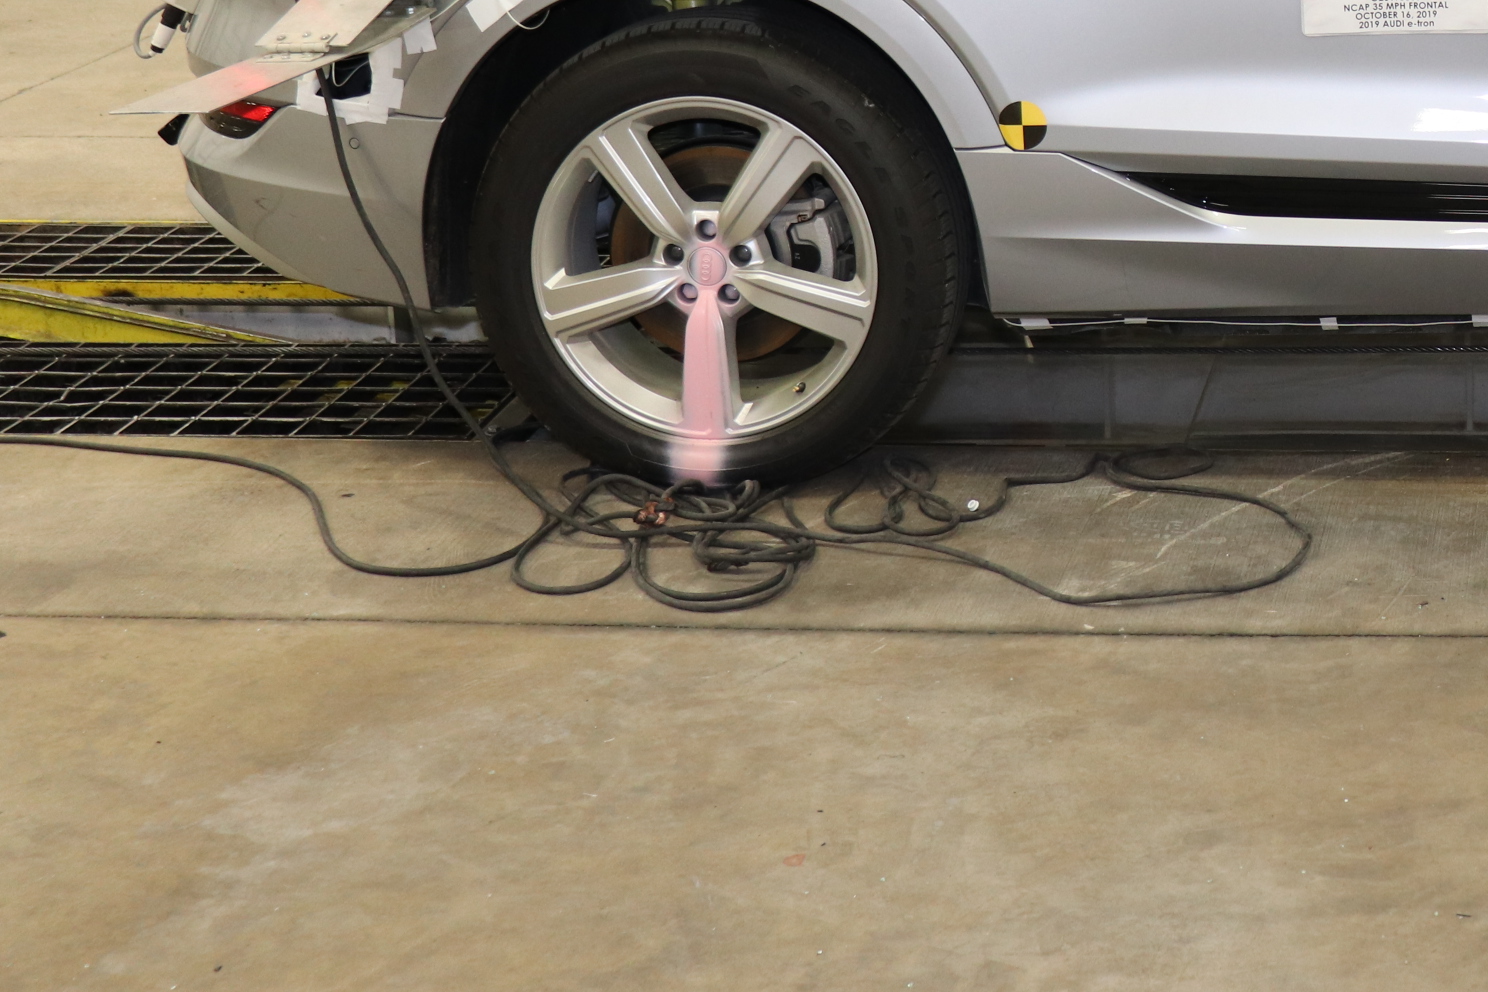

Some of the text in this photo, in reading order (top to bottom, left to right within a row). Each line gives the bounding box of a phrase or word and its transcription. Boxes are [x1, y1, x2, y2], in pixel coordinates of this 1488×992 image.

[1343, 1, 1449, 12] NCAP 35 MPH FRONTAL
[1355, 10, 1438, 20] OCTOBER 16, 2019
[1359, 20, 1435, 29] 2019 AUDI e-tron
